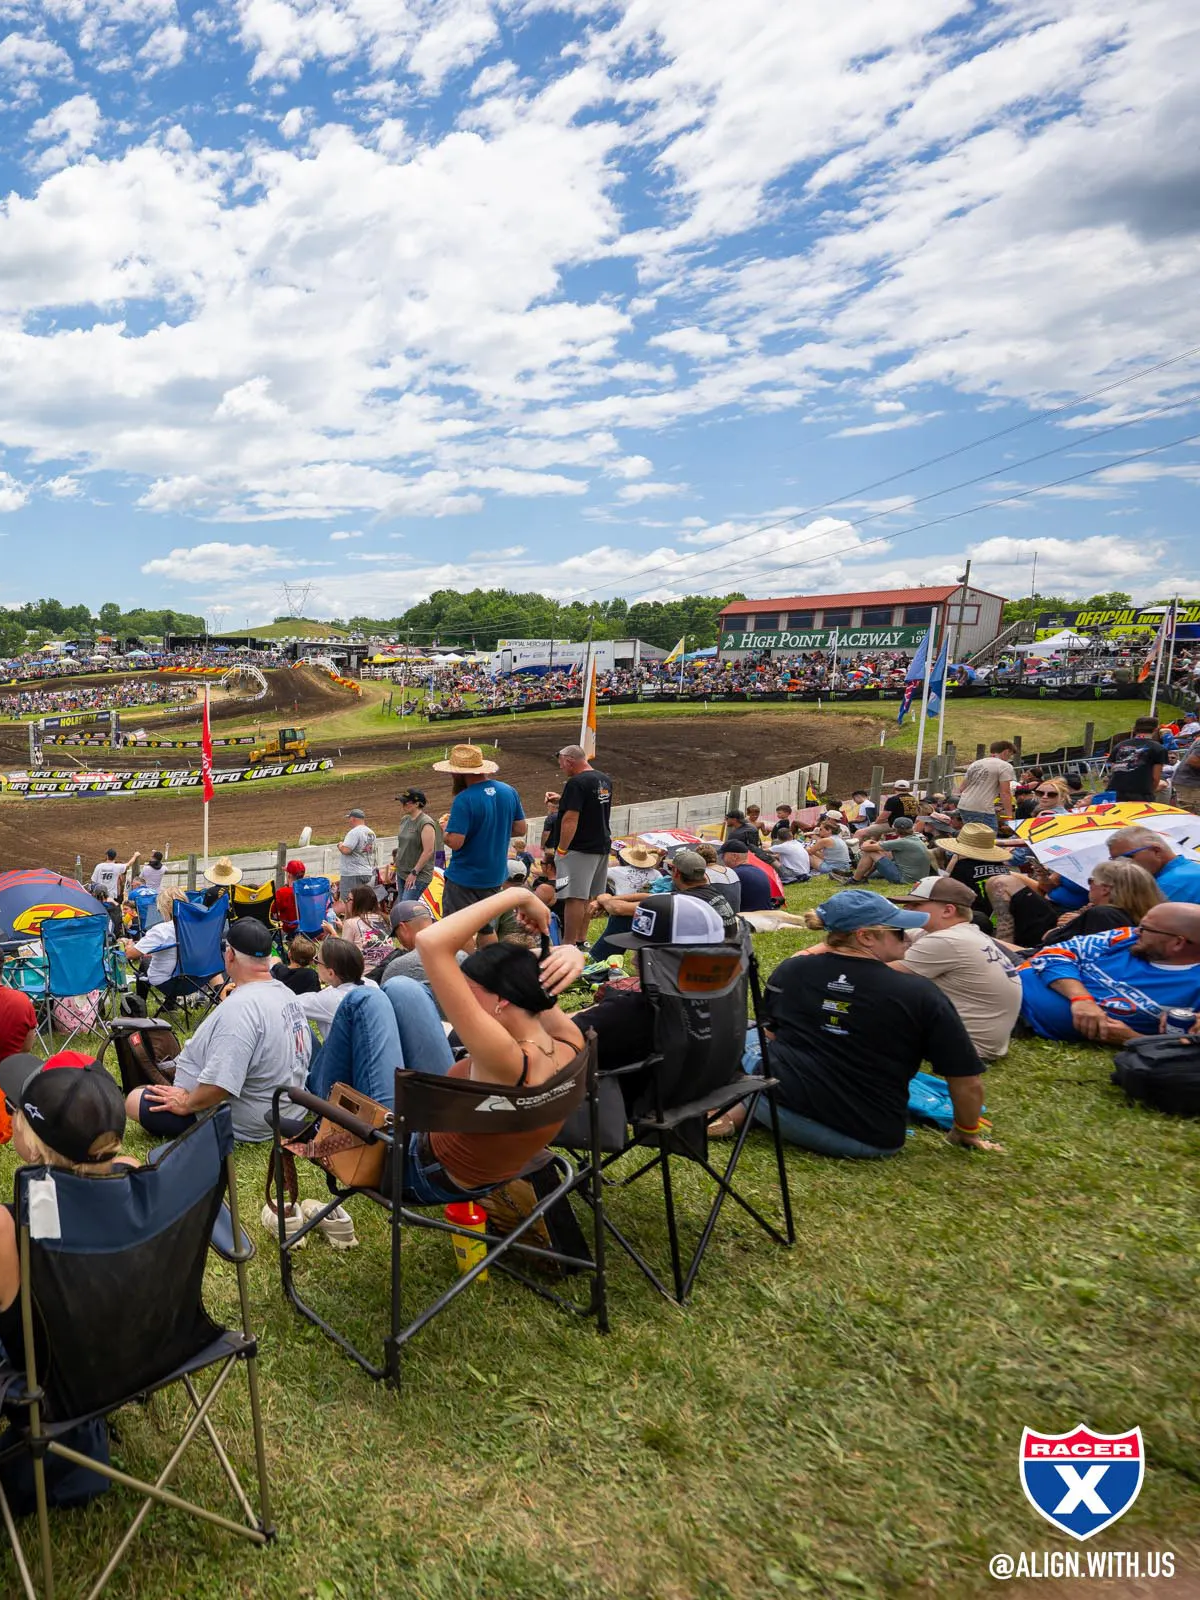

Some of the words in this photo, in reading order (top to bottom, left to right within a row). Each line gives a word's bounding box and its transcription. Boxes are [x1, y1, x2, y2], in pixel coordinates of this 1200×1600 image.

[1075, 610, 1136, 626] OFFICIAL
[739, 633, 777, 648] HIGH
[779, 631, 825, 648] POINT
[826, 630, 904, 648] RACEWAY
[35, 783, 57, 791] UFO
[64, 783, 90, 791] UFO
[96, 782, 123, 791] UFO
[130, 780, 160, 789] UFO
[169, 777, 199, 787] UFO
[251, 766, 283, 778] UFO
[292, 762, 318, 773] UFO
[101, 872, 113, 880] 16
